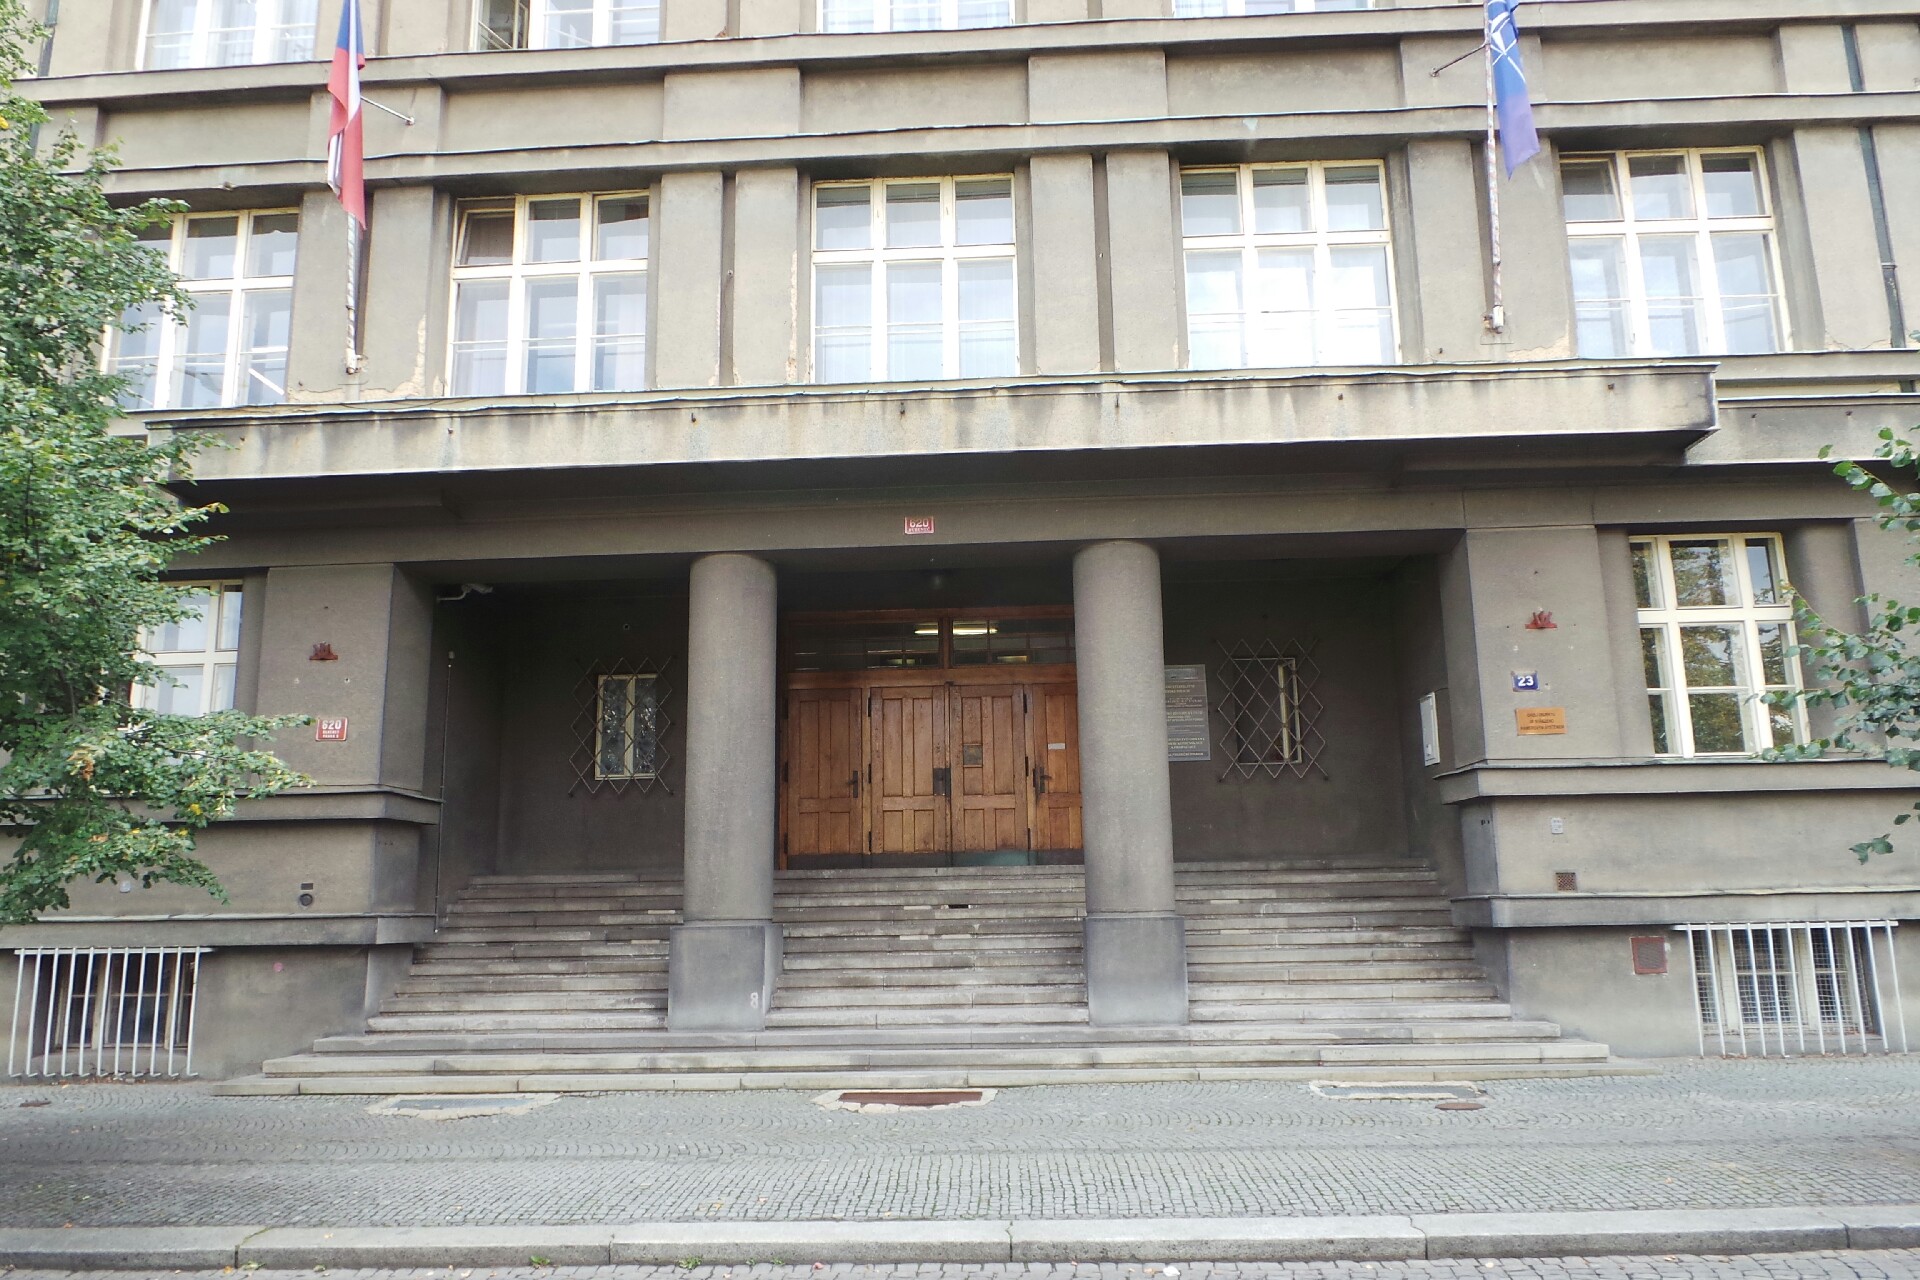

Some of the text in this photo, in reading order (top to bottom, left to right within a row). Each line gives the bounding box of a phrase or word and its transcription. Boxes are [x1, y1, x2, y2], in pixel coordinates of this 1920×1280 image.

[909, 519, 929, 528] 620
[1517, 675, 1534, 687] 23
[322, 719, 342, 730] 620
